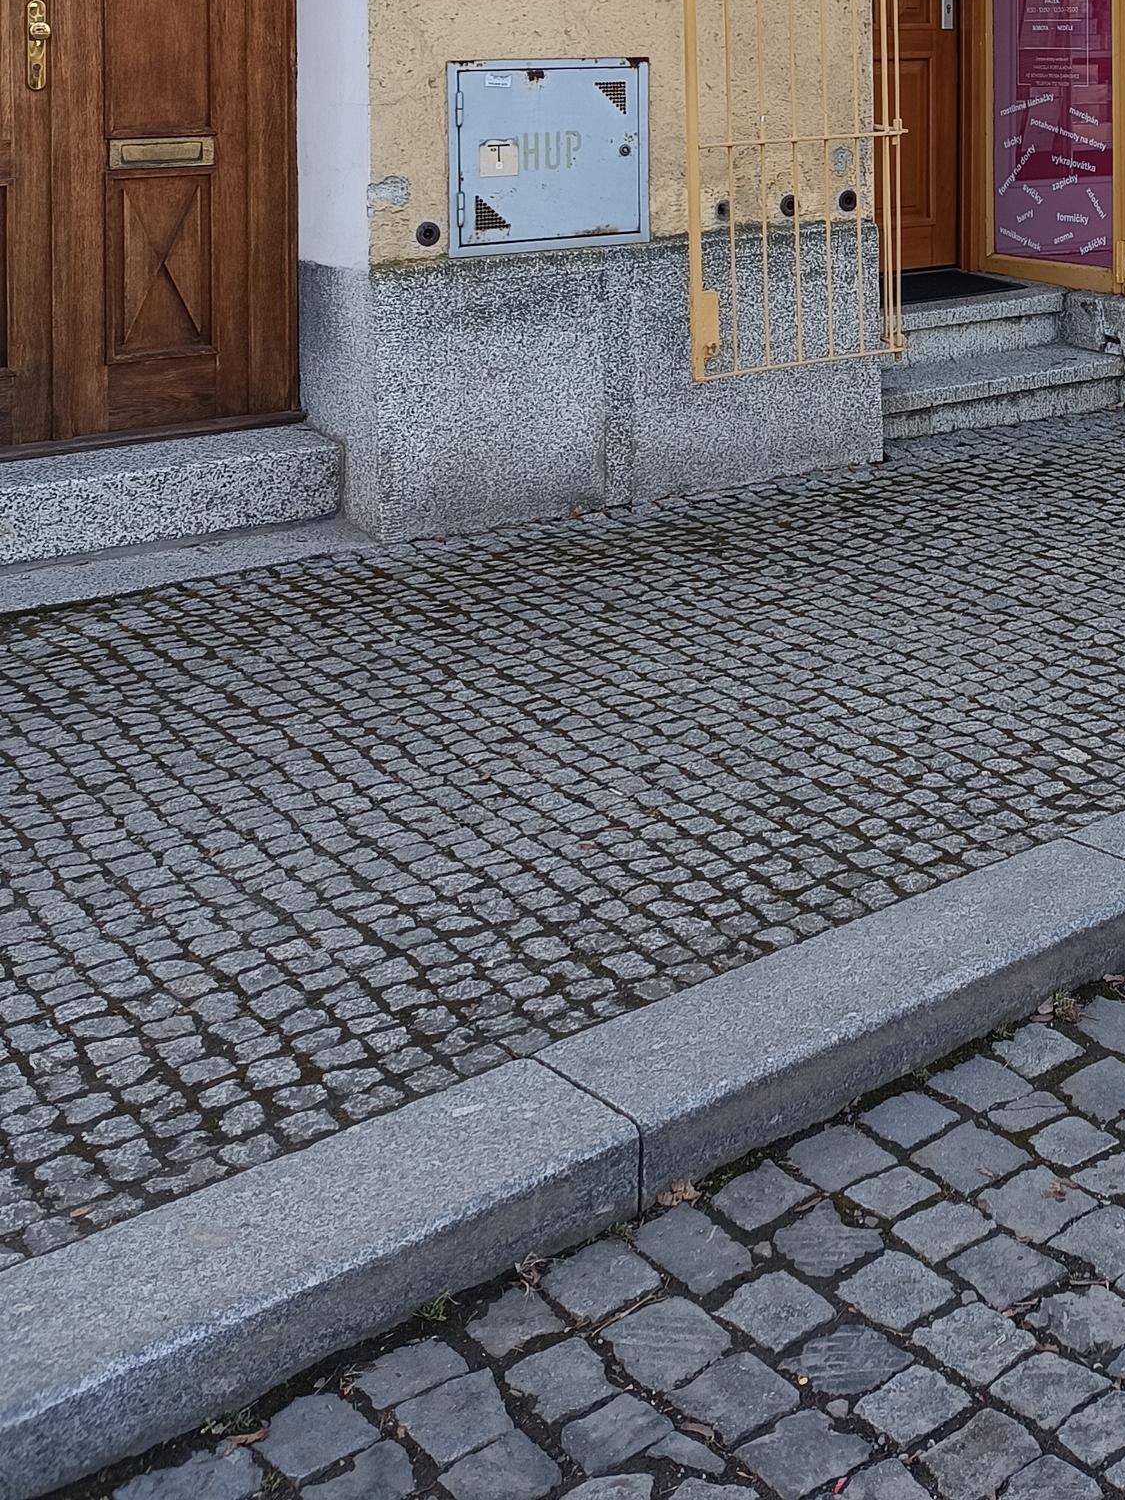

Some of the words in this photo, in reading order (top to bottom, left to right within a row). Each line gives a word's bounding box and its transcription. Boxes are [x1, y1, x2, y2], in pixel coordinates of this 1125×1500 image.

[1068, 106, 1100, 127] marcipán
[1059, 126, 1080, 142] hmoty
[1080, 136, 1089, 144] na
[1088, 137, 1107, 152] dorty
[523, 130, 582, 171] HUP
[998, 173, 1016, 196] formy
[1013, 164, 1022, 176] na
[1020, 144, 1036, 165] dorty
[1051, 155, 1096, 173] vykrajovátka
[1022, 184, 1044, 205] svíčky
[1016, 209, 1034, 223] barvy
[1056, 212, 1089, 225] formičky
[1053, 231, 1074, 245] aroma
